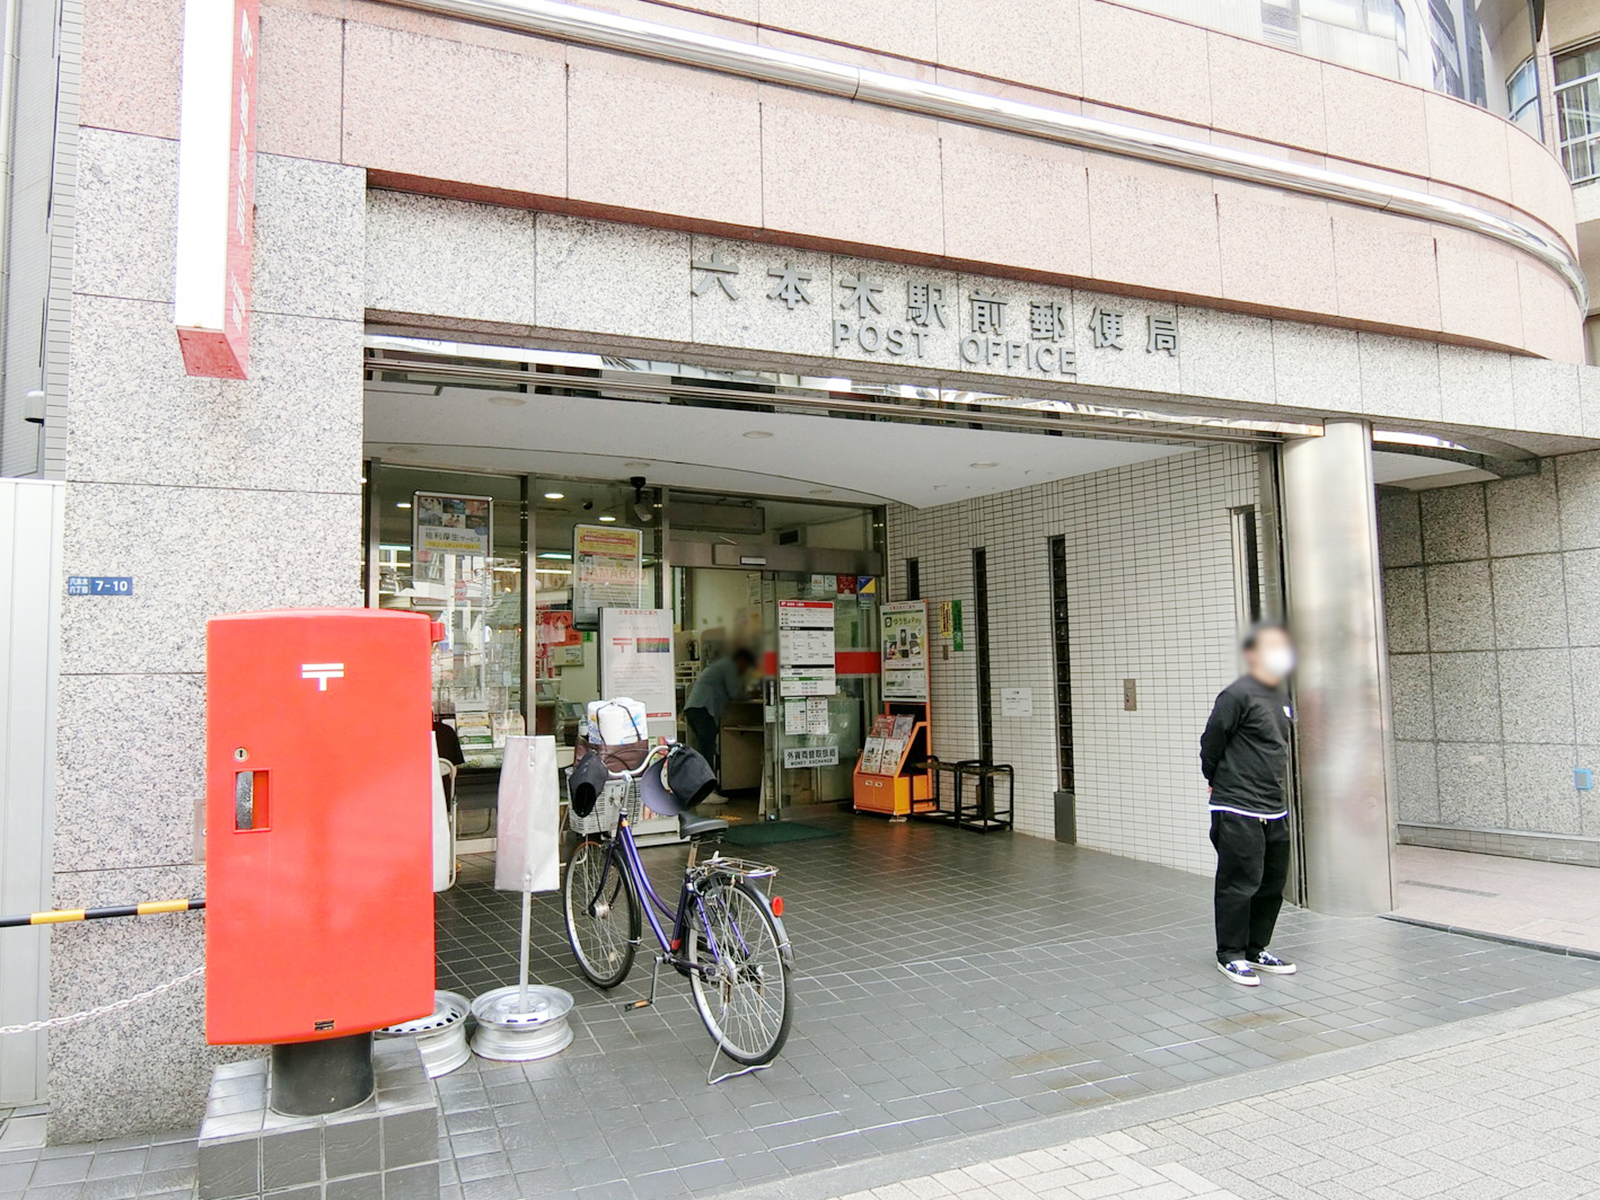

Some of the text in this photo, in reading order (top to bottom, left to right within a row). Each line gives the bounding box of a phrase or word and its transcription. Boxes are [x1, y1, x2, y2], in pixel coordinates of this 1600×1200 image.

[691, 253, 1180, 356] 六本木駅前郵便局
[833, 318, 1077, 375] POST OFFICE
[95, 580, 128, 592] 7-10
